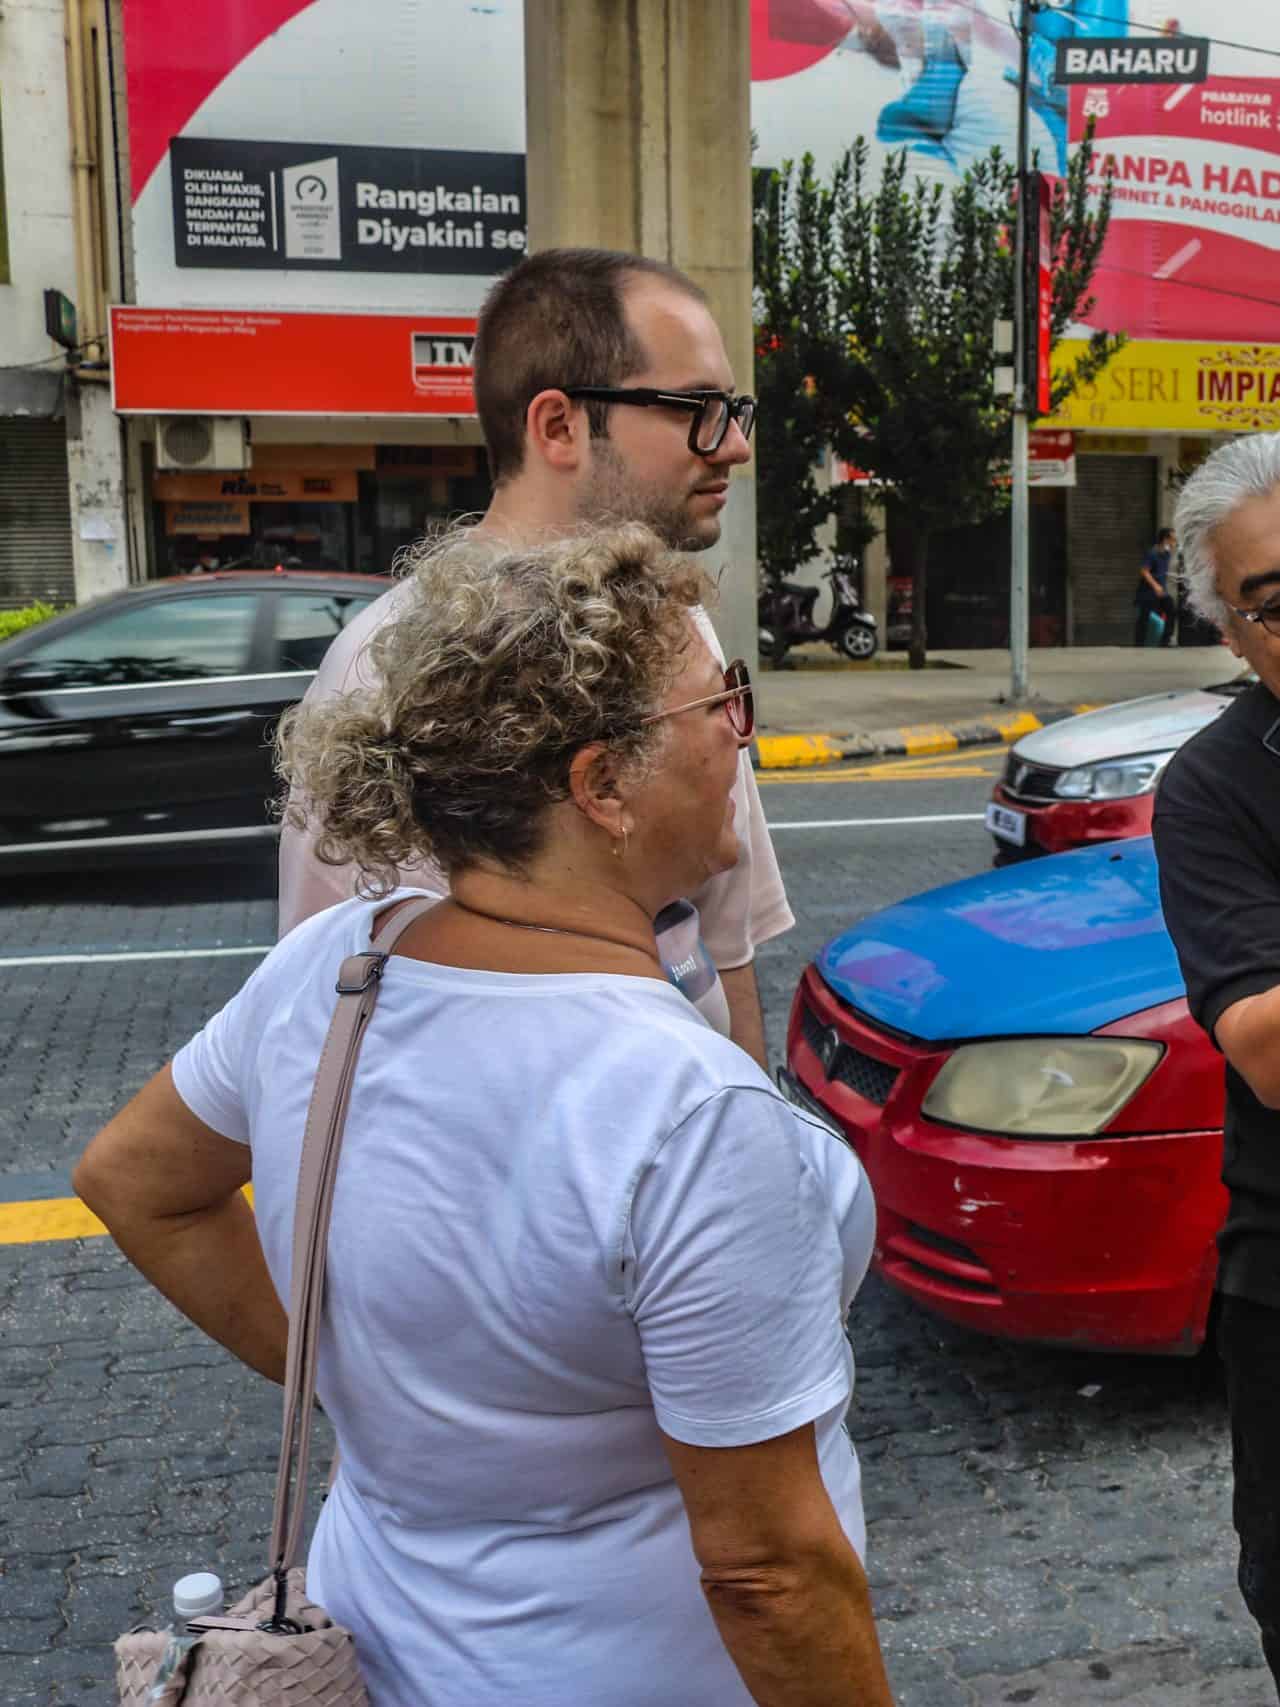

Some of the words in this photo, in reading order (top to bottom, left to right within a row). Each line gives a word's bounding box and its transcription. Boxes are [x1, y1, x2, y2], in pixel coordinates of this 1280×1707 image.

[1065, 48, 1198, 75] BAHARU
[1201, 105, 1271, 128] hotlink
[184, 169, 244, 182] DIKUASAI
[1086, 152, 1192, 188] TANPA
[184, 182, 219, 194] OLEH
[221, 184, 265, 197] MAXIS,
[185, 195, 260, 209] RANGKAIAN
[356, 182, 521, 217] Rangkaian
[1165, 193, 1176, 208] &
[186, 208, 234, 221] MUDAH
[236, 210, 265, 222] ALIH
[187, 221, 259, 235] TERPANTAS
[187, 234, 201, 246] DI
[203, 235, 266, 248] MALAYSIA
[357, 218, 484, 252] Diyakini
[491, 226, 528, 255] se
[1111, 367, 1179, 401] SERI
